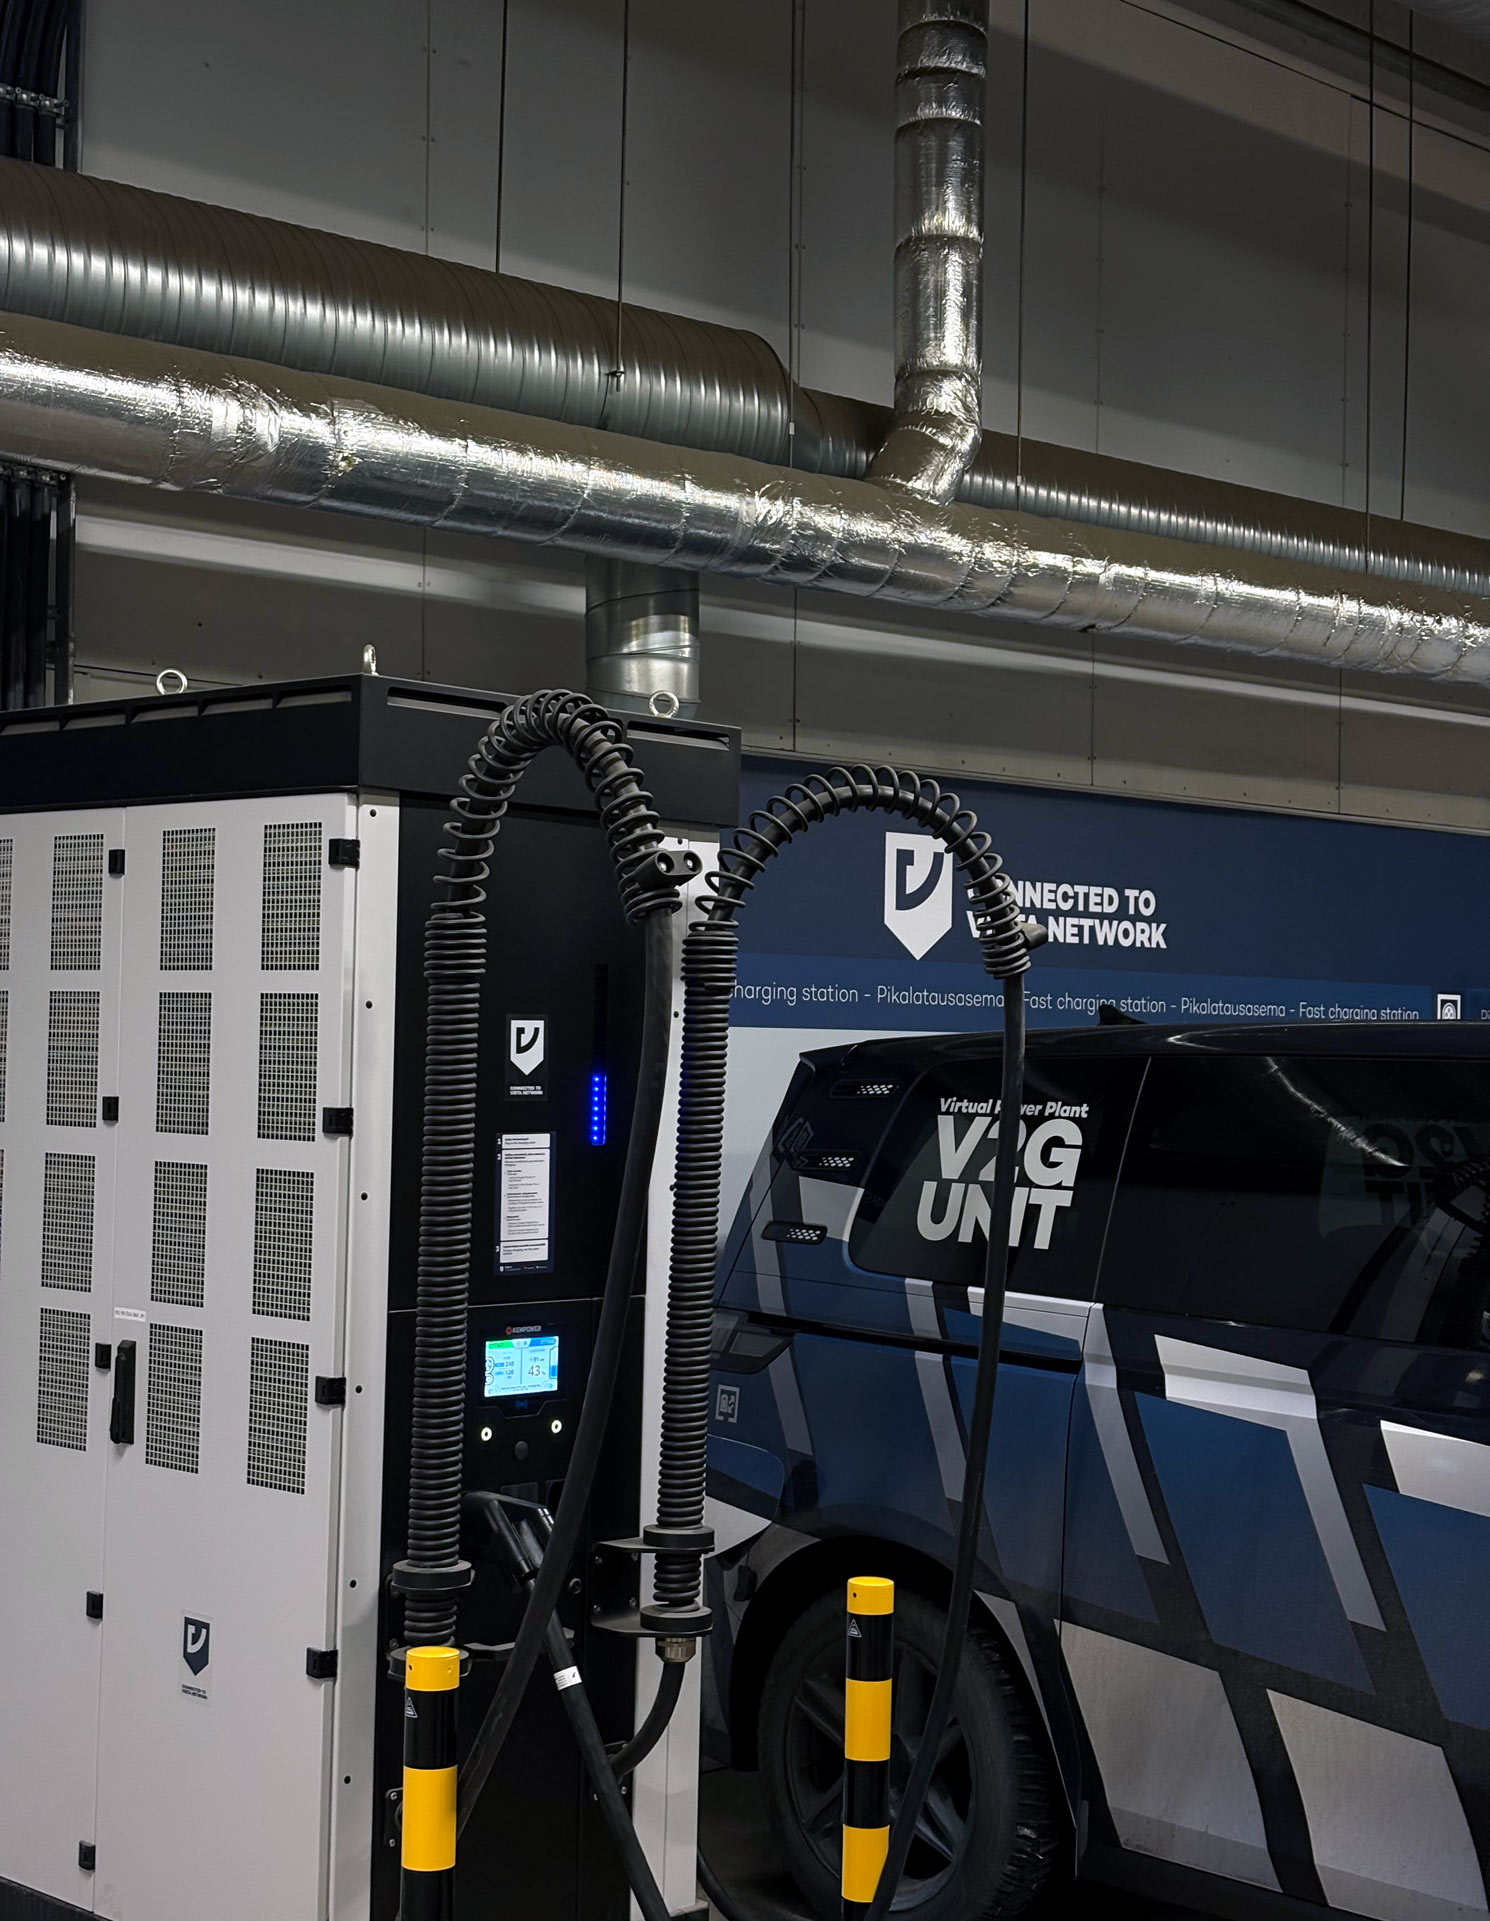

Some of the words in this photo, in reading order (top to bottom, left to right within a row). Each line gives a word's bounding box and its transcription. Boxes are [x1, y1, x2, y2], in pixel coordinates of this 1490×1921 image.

[967, 879, 1119, 914] NNECTED
[1125, 889, 1156, 917] TO
[1048, 915, 1168, 949] NETWORK
[802, 983, 859, 1003] station
[877, 985, 1005, 1008] Pikalatausasema
[1120, 995, 1167, 1014] station
[1181, 997, 1286, 1018] Pikalatausasema
[1299, 1002, 1326, 1019] Fast
[1380, 1005, 1420, 1021] station
[940, 1097, 992, 1114] Virtual
[1044, 1101, 1090, 1118] Plant
[917, 1180, 1074, 1250] UNIT
[528, 1364, 541, 1377] 43
